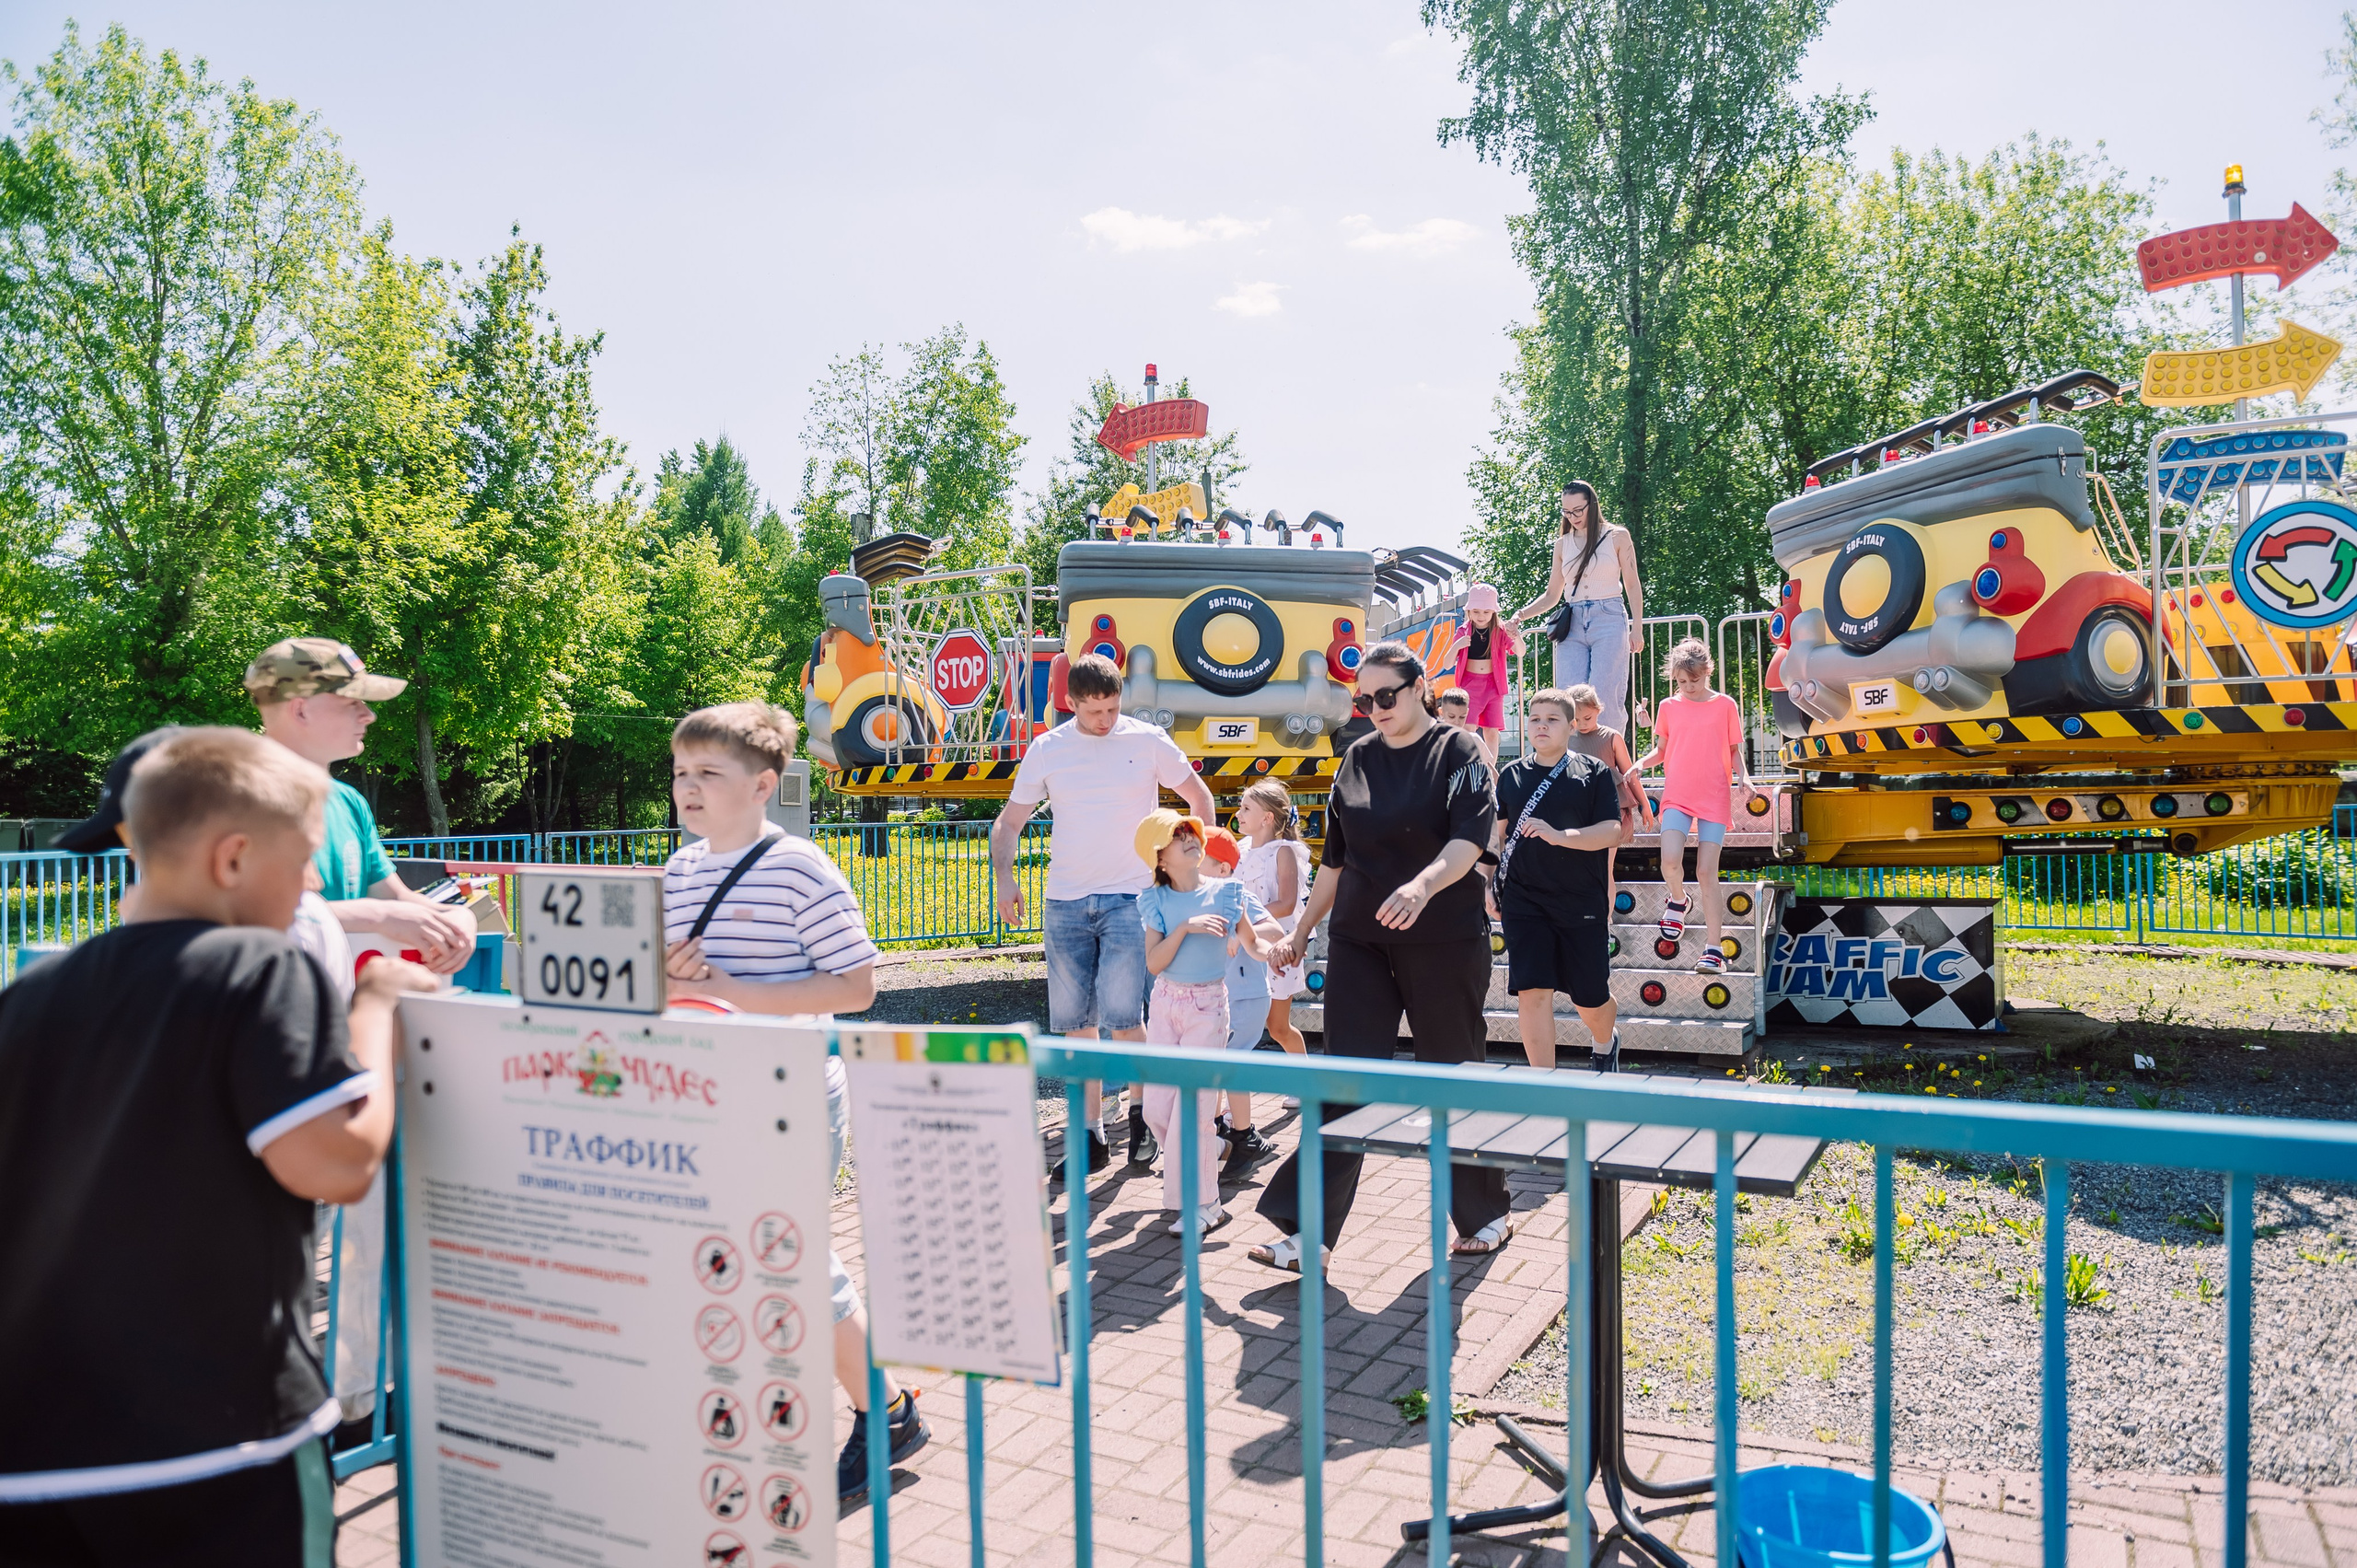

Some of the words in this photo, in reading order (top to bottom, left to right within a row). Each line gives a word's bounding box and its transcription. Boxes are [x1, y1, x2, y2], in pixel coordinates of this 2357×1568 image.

[1846, 534, 1886, 554] SBF-ITALY
[1208, 597, 1253, 610] SBF-ITALY
[937, 655, 985, 691] STOP
[1197, 656, 1271, 679] www.sbfrides.com
[1864, 689, 1888, 705] SBF
[1217, 725, 1248, 738] SBF
[540, 883, 583, 926] 42
[1772, 932, 1971, 984] RAFFIC
[540, 953, 634, 1003] 0091
[521, 1125, 701, 1176] ТРАФФИК
